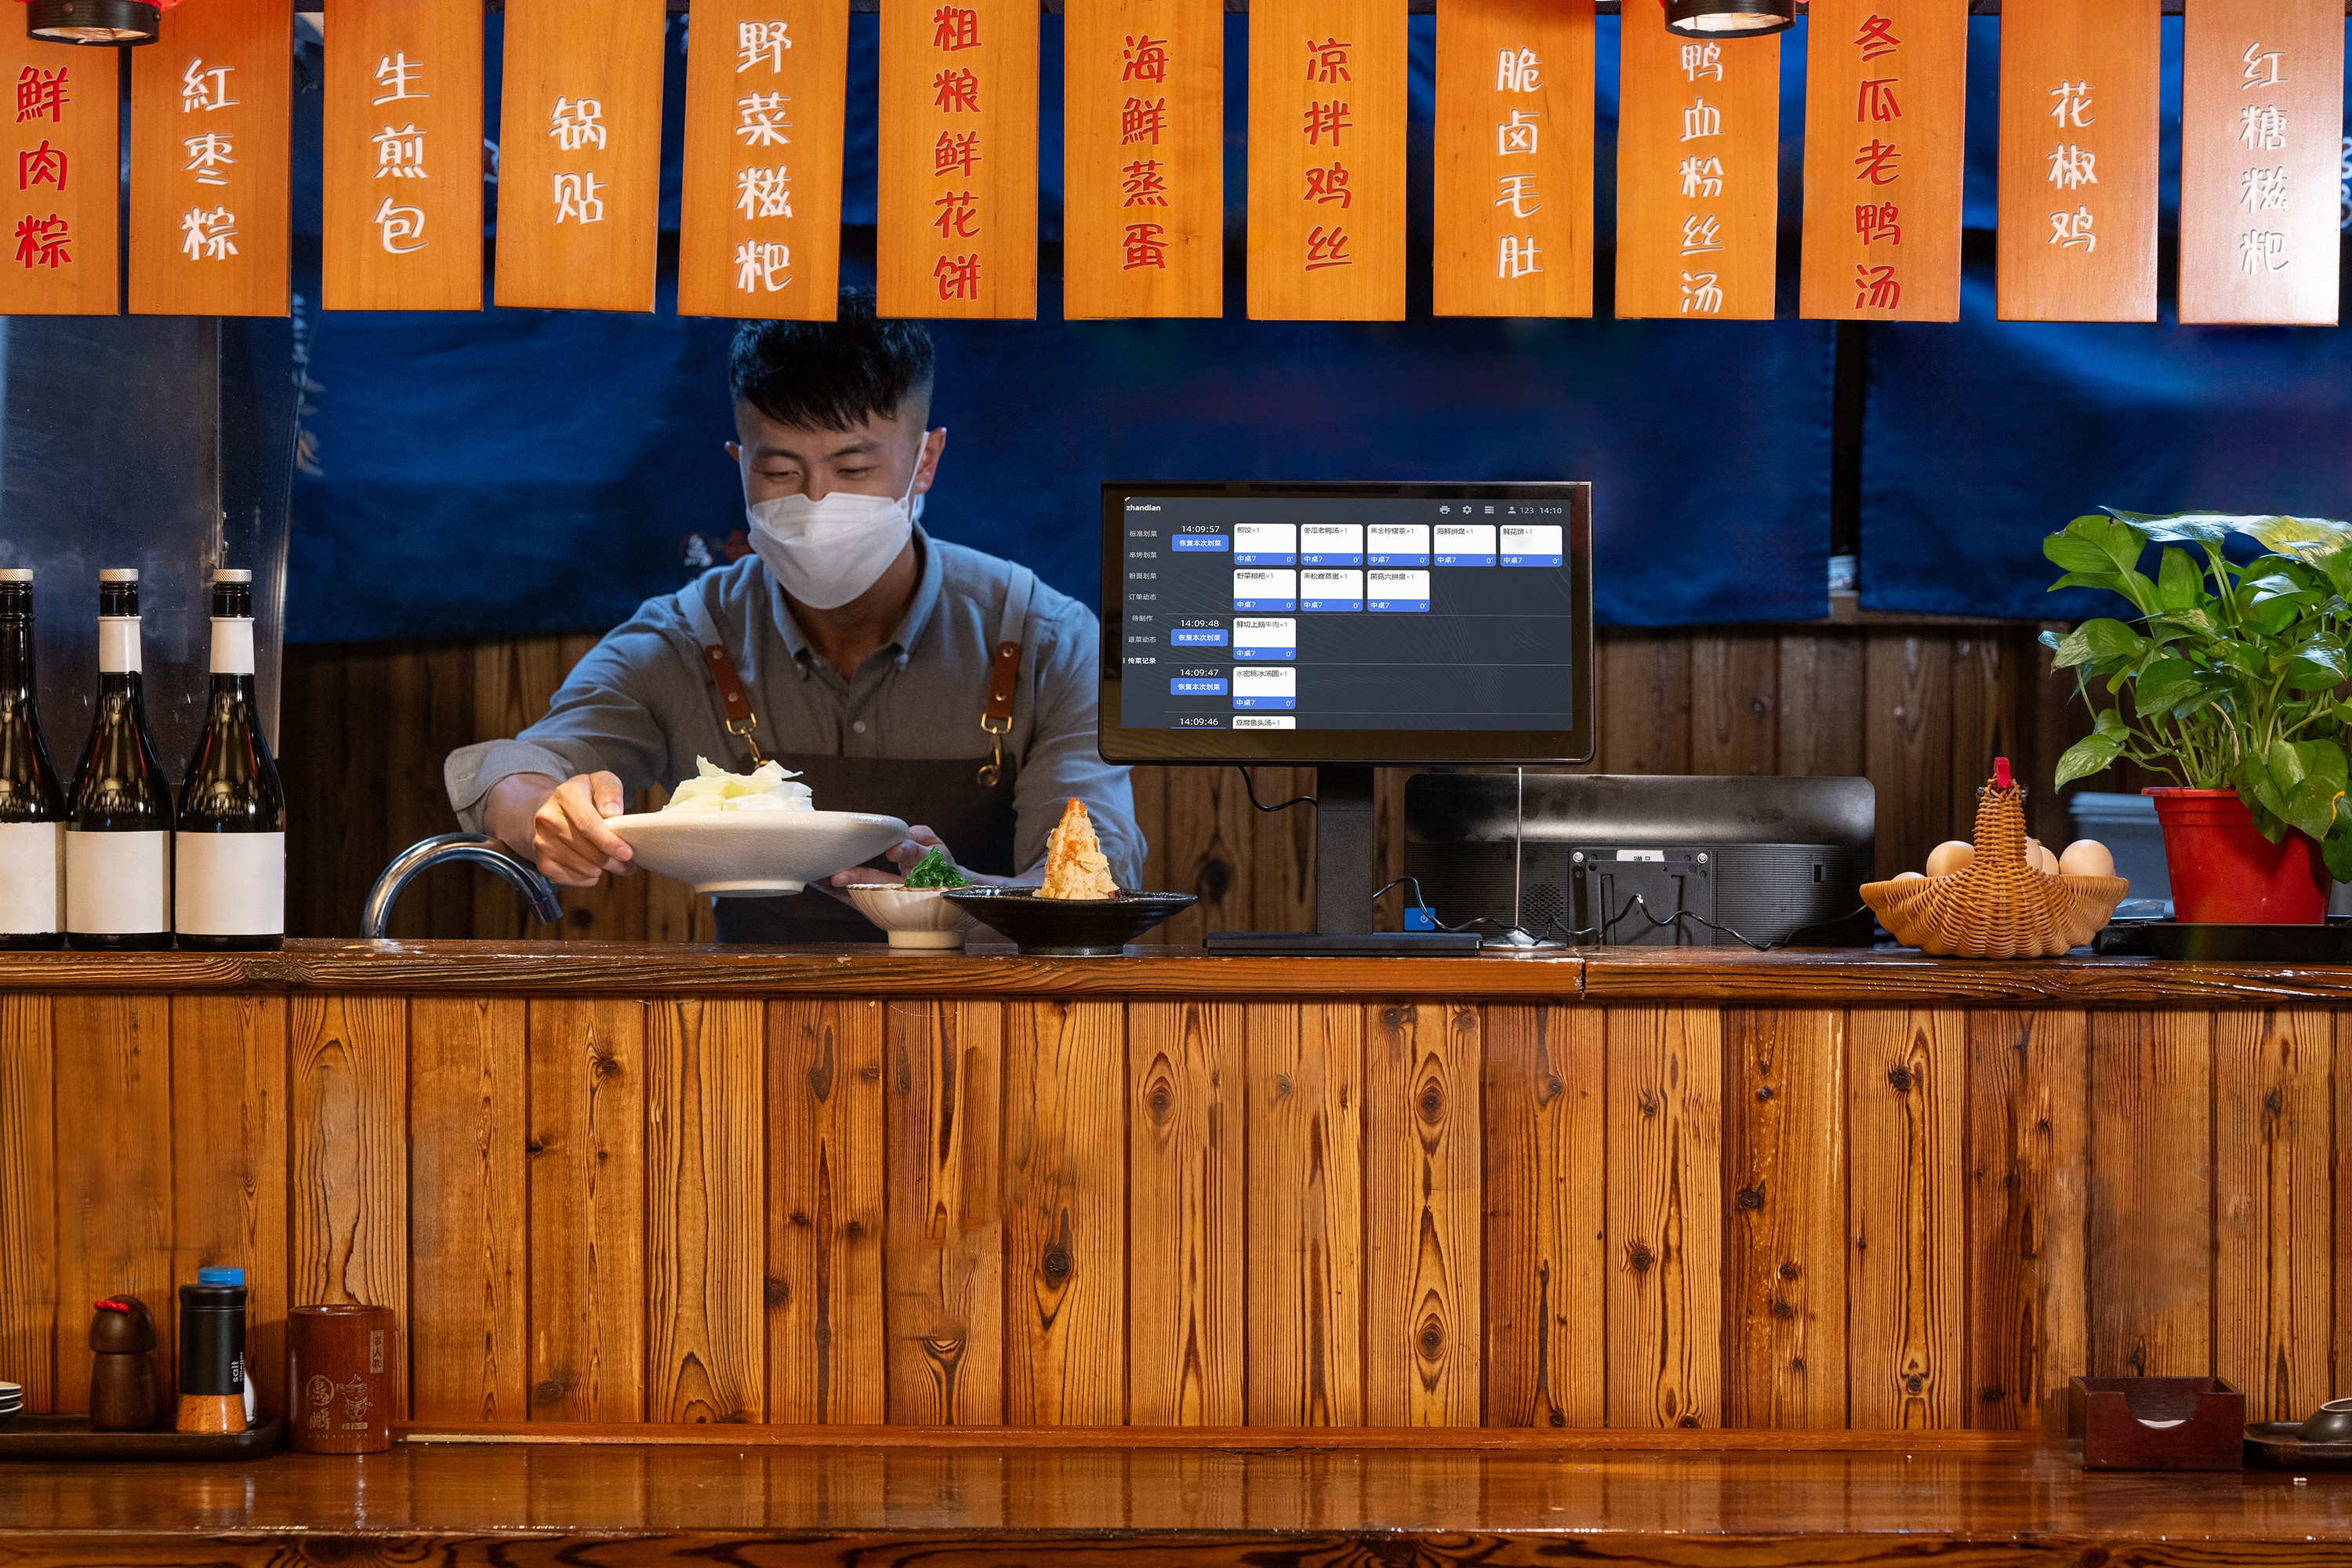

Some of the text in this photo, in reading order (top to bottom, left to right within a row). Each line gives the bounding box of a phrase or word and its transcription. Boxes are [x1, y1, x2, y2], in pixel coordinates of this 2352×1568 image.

[372, 51, 430, 254] 生煎包
[735, 20, 793, 293] 野菜糍粑
[933, 6, 982, 302] 粗粮鲜花饼
[1121, 34, 1171, 271] 海鮮蒸蛋
[1303, 37, 1353, 272] 凉拌鸡丝
[181, 56, 240, 262] 紅枣粽
[548, 96, 608, 225] 锅贴
[1495, 46, 1543, 279] 脆卤毛肚
[1853, 14, 1903, 310] 冬瓜老鸭汤
[2239, 41, 2289, 275] 红糖糍粑
[14, 66, 73, 270] 鮮肉粽
[2047, 80, 2099, 252] 花椒鸡
[1679, 40, 1724, 314] 鸭血粉丝汤
[1178, 539, 1222, 548] 恢复本次划菜
[1236, 554, 1258, 564] 中桌7
[1303, 555, 1324, 564] 中桌7
[1370, 555, 1391, 564] 中桌7
[1436, 555, 1457, 564] 中桌7
[1503, 556, 1524, 565] 中桌7
[1236, 601, 1258, 610] 中桌7
[1303, 601, 1324, 610] 中桌7
[1370, 601, 1391, 610] 中桌7
[1131, 614, 1153, 622] 待制作
[1180, 619, 1220, 628] 14:09:48
[1177, 633, 1221, 642] 恢复本次划菜
[1236, 649, 1257, 659] 中桌7
[1127, 656, 1156, 665] 传菜记录
[1236, 699, 1257, 708] 中桌7
[1179, 717, 1219, 726] 14:09:46
[230, 1361, 239, 1382] salt
